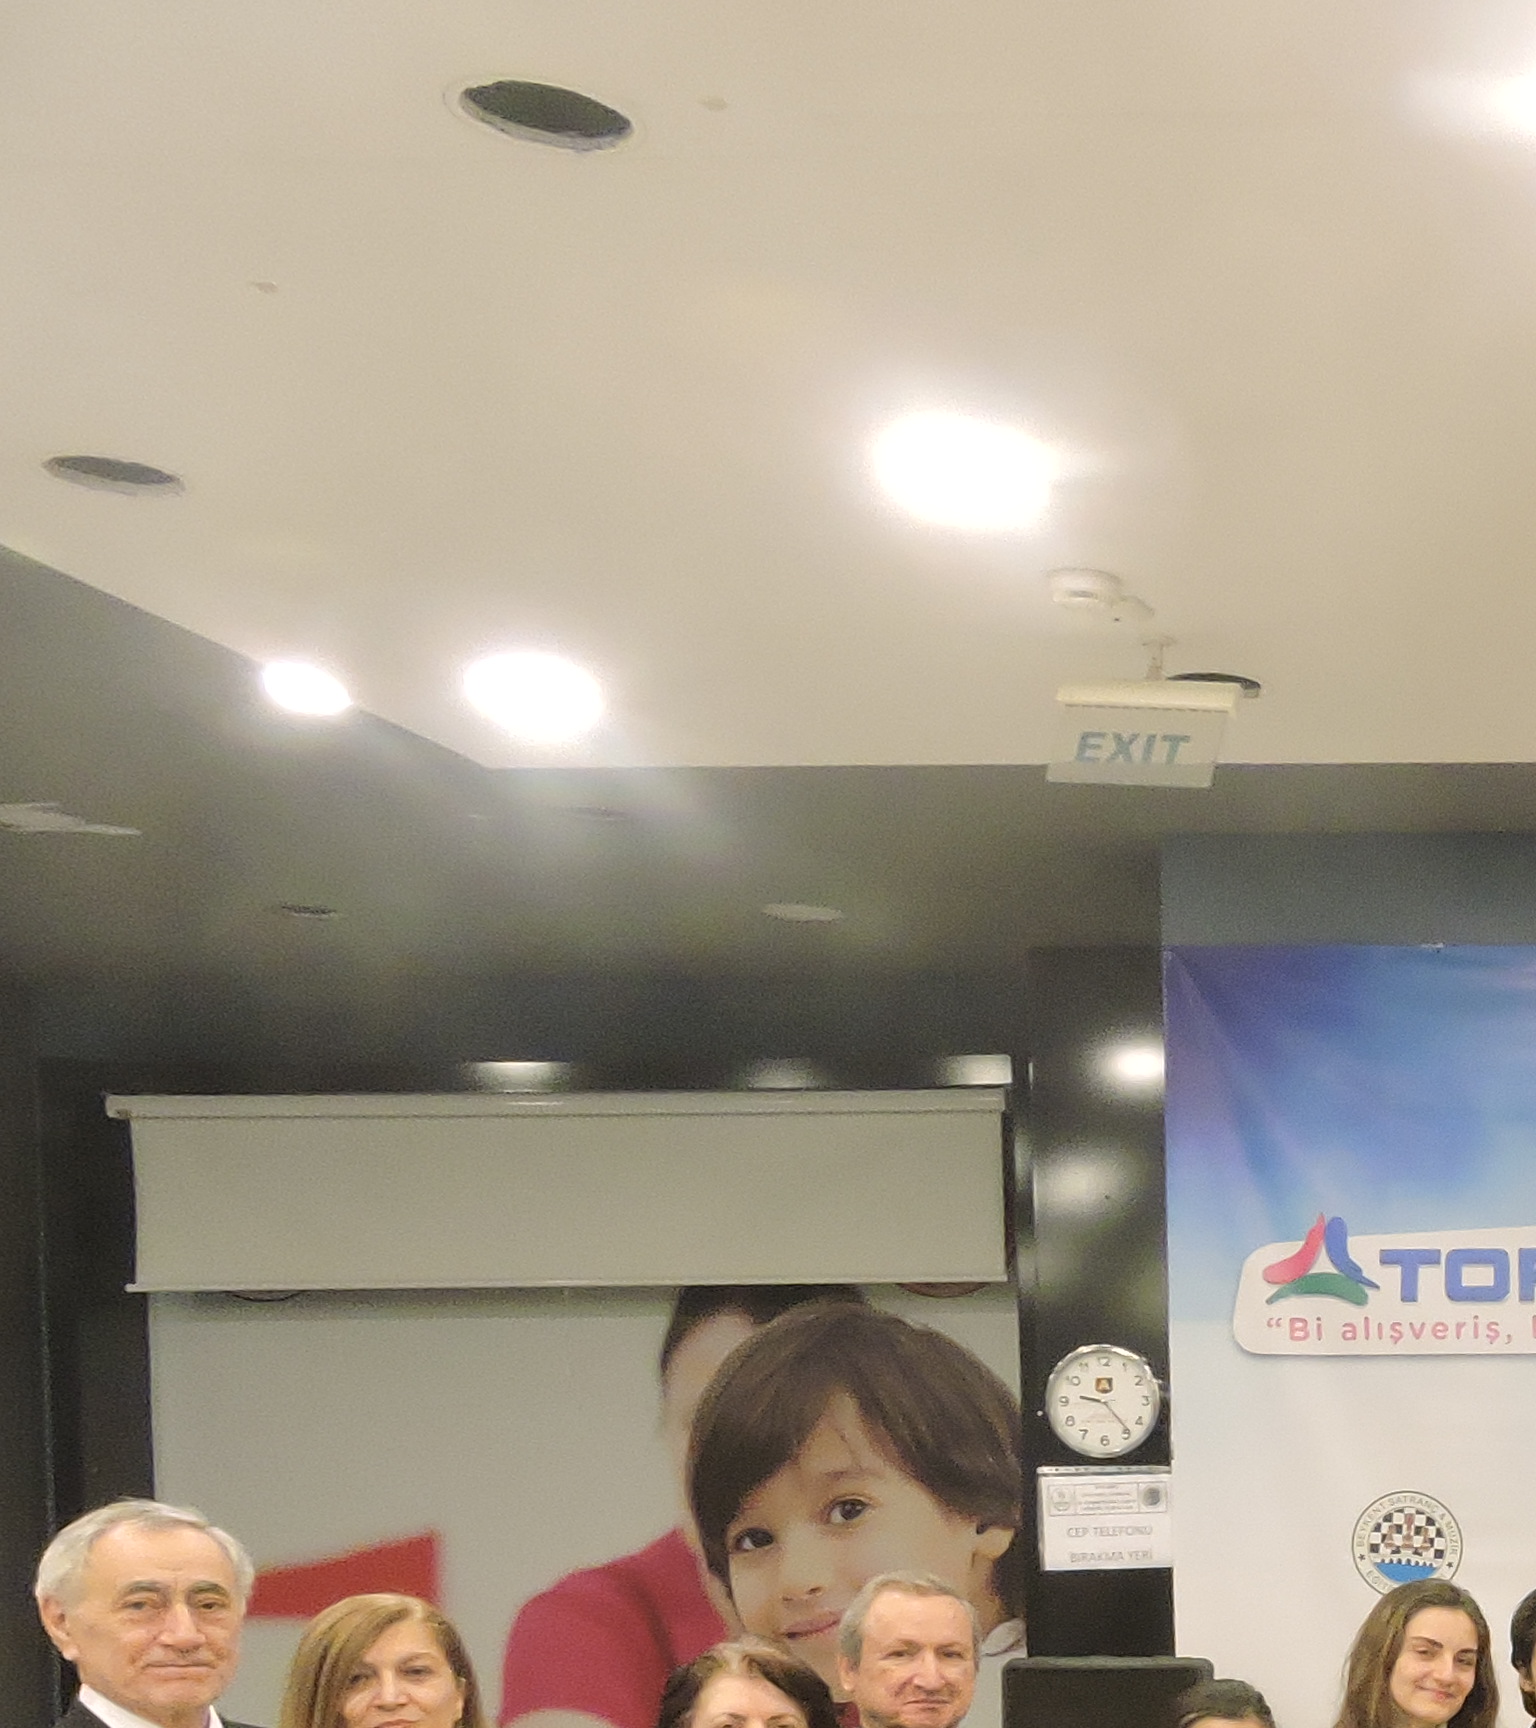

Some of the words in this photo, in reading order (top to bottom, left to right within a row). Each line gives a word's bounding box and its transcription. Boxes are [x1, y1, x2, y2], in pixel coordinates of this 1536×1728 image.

[1074, 731, 1191, 765] EXIT
[1134, 1375, 1143, 1386] 2
[1059, 1396, 1069, 1407] 9
[1142, 1395, 1150, 1406] 3
[1065, 1415, 1075, 1427] 8
[1135, 1416, 1143, 1426] 4
[1078, 1429, 1089, 1440] 7
[1121, 1428, 1131, 1440] 5
[1100, 1435, 1110, 1446] 6
